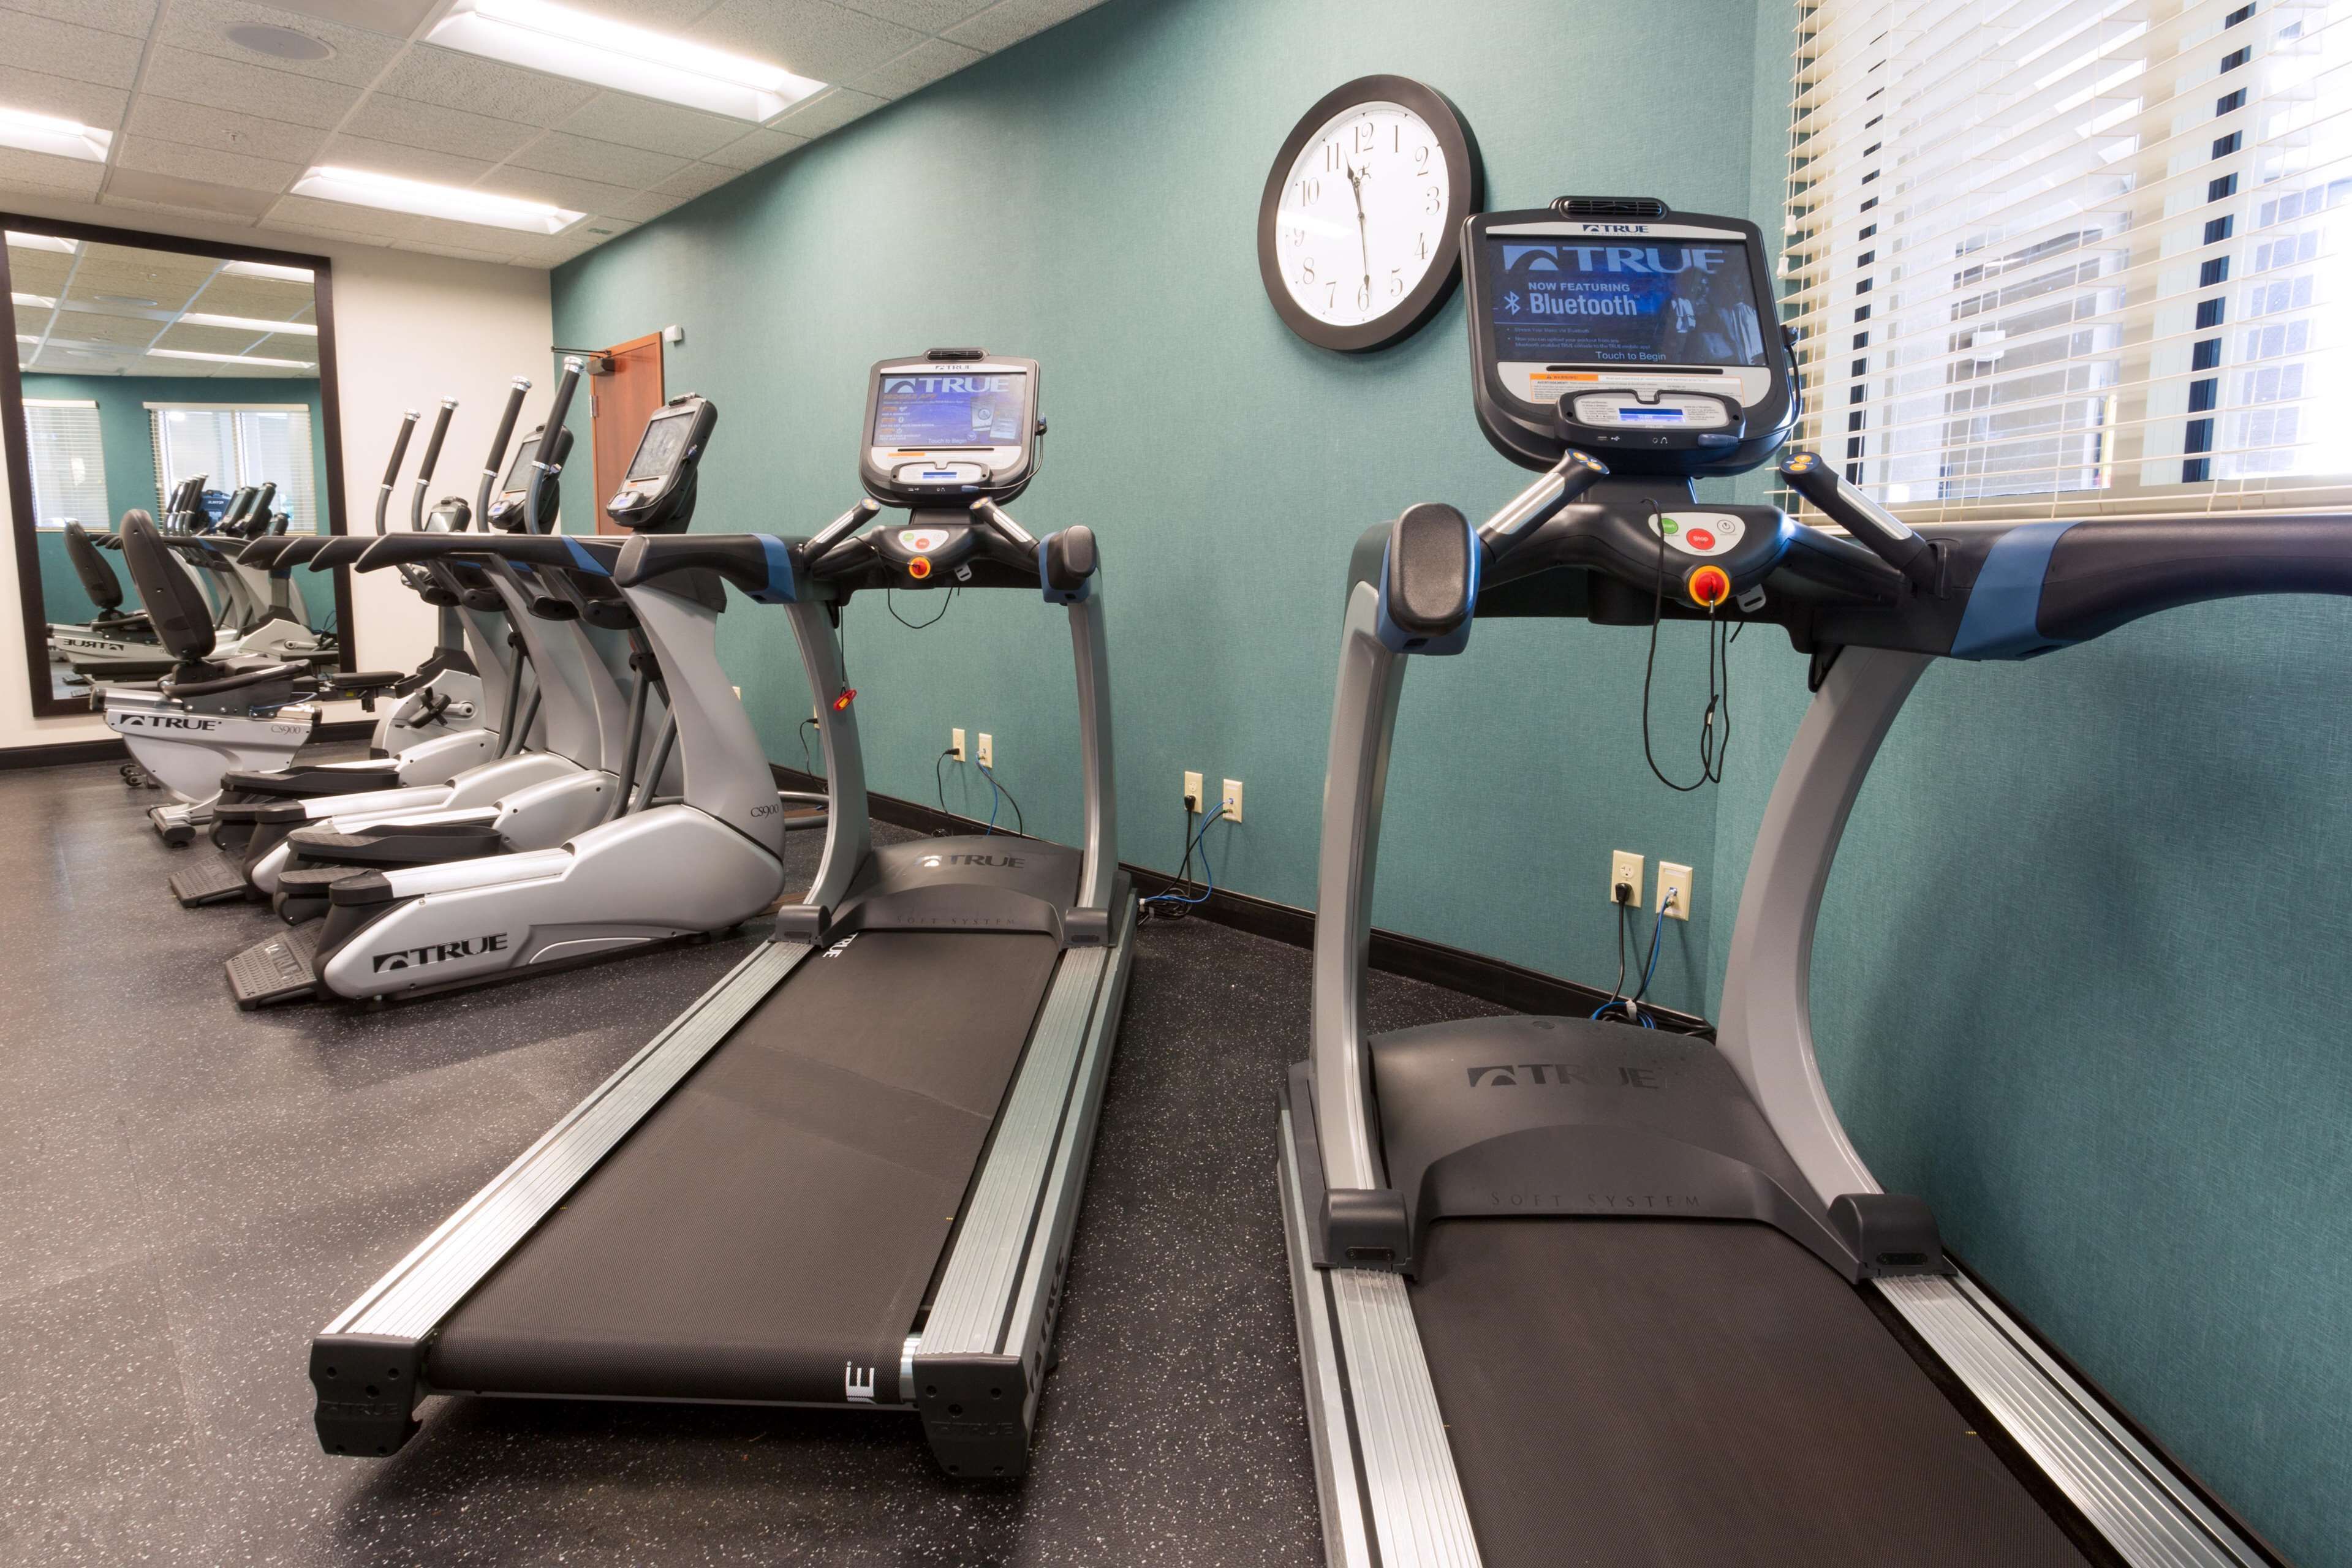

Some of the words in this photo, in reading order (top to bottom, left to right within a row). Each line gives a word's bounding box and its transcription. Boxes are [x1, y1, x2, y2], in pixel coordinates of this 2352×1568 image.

[1353, 122, 1374, 154] 12
[1393, 124, 1399, 153] 1
[1326, 142, 1339, 172] 11
[1415, 146, 1429, 176] 2
[1302, 176, 1320, 206] 10
[1426, 186, 1440, 215] 3
[1600, 224, 1649, 233] TRUE
[1414, 232, 1429, 260] 4
[1562, 246, 1725, 274] TRUE
[1302, 257, 1315, 285] 8
[1390, 268, 1403, 297] 5
[1325, 281, 1337, 309] 7
[1357, 284, 1370, 312] 6
[1528, 282, 1557, 291] NOW
[1560, 282, 1630, 292] FEATURING
[1529, 292, 1638, 315] Bluetooth
[1595, 351, 1625, 360] Touch
[1639, 352, 1666, 362] Begin
[918, 377, 1010, 393] TRUE
[147, 715, 216, 731] TRUE
[270, 726, 301, 736] CS900
[750, 803, 779, 819] CS900
[948, 854, 1026, 869] TRUE
[409, 932, 508, 965] TRUE
[822, 932, 858, 958] TRUE
[1491, 1191, 1562, 1207] SOFT
[1587, 1194, 1701, 1207] SYSTEM
